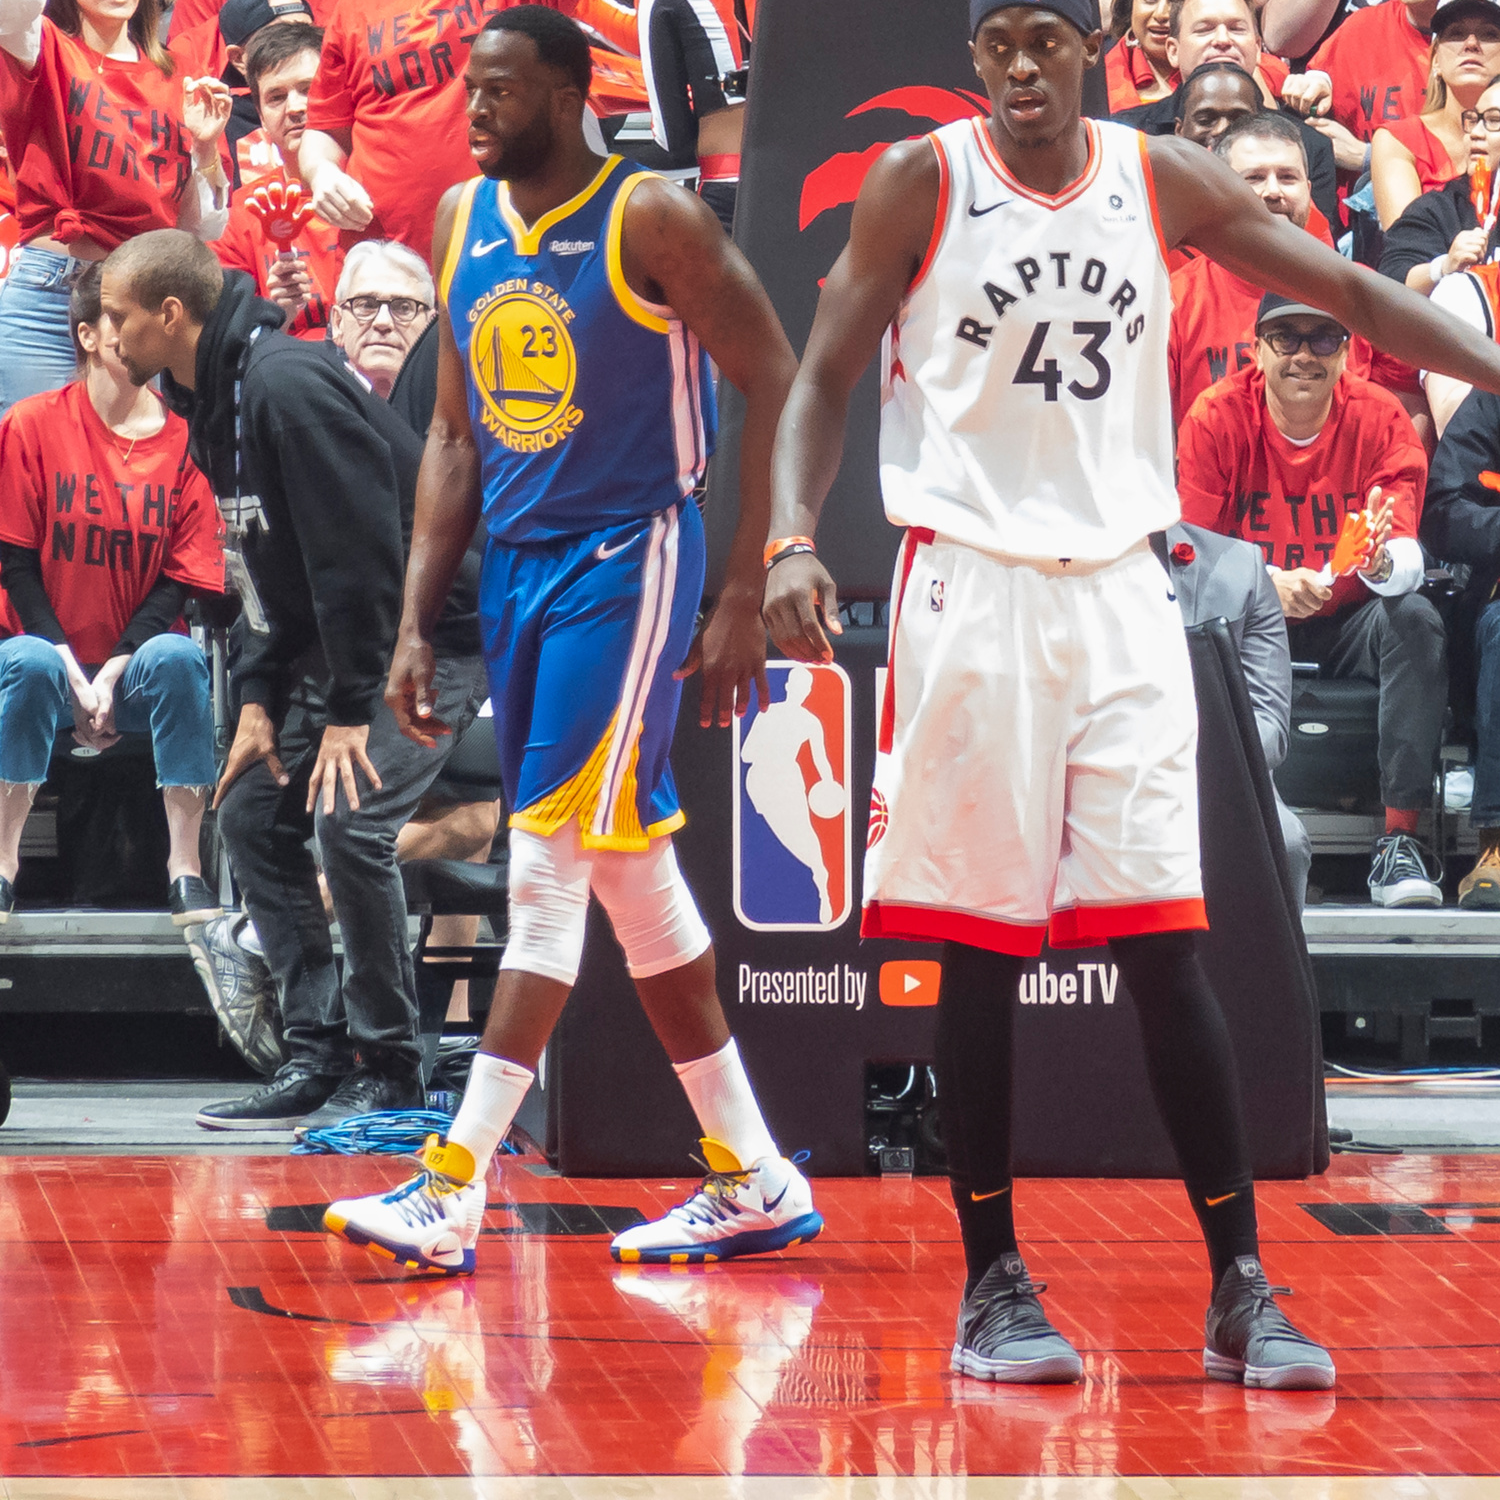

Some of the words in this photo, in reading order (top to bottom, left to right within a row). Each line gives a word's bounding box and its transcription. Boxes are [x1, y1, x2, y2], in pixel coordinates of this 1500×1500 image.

[68, 77, 114, 125] WE
[1359, 85, 1401, 121] WE
[551, 239, 595, 255] Rakuten
[467, 278, 528, 324] GOLDEN
[530, 278, 578, 325] STATE
[955, 251, 1145, 351] RAPTORS
[520, 325, 559, 359] 23
[1011, 320, 1113, 403] 43
[479, 403, 586, 454] WARRIORS
[54, 471, 102, 515] WE
[739, 963, 837, 1004] Presented
[843, 963, 867, 1011] by
[1018, 961, 1119, 1005] ubeTV
